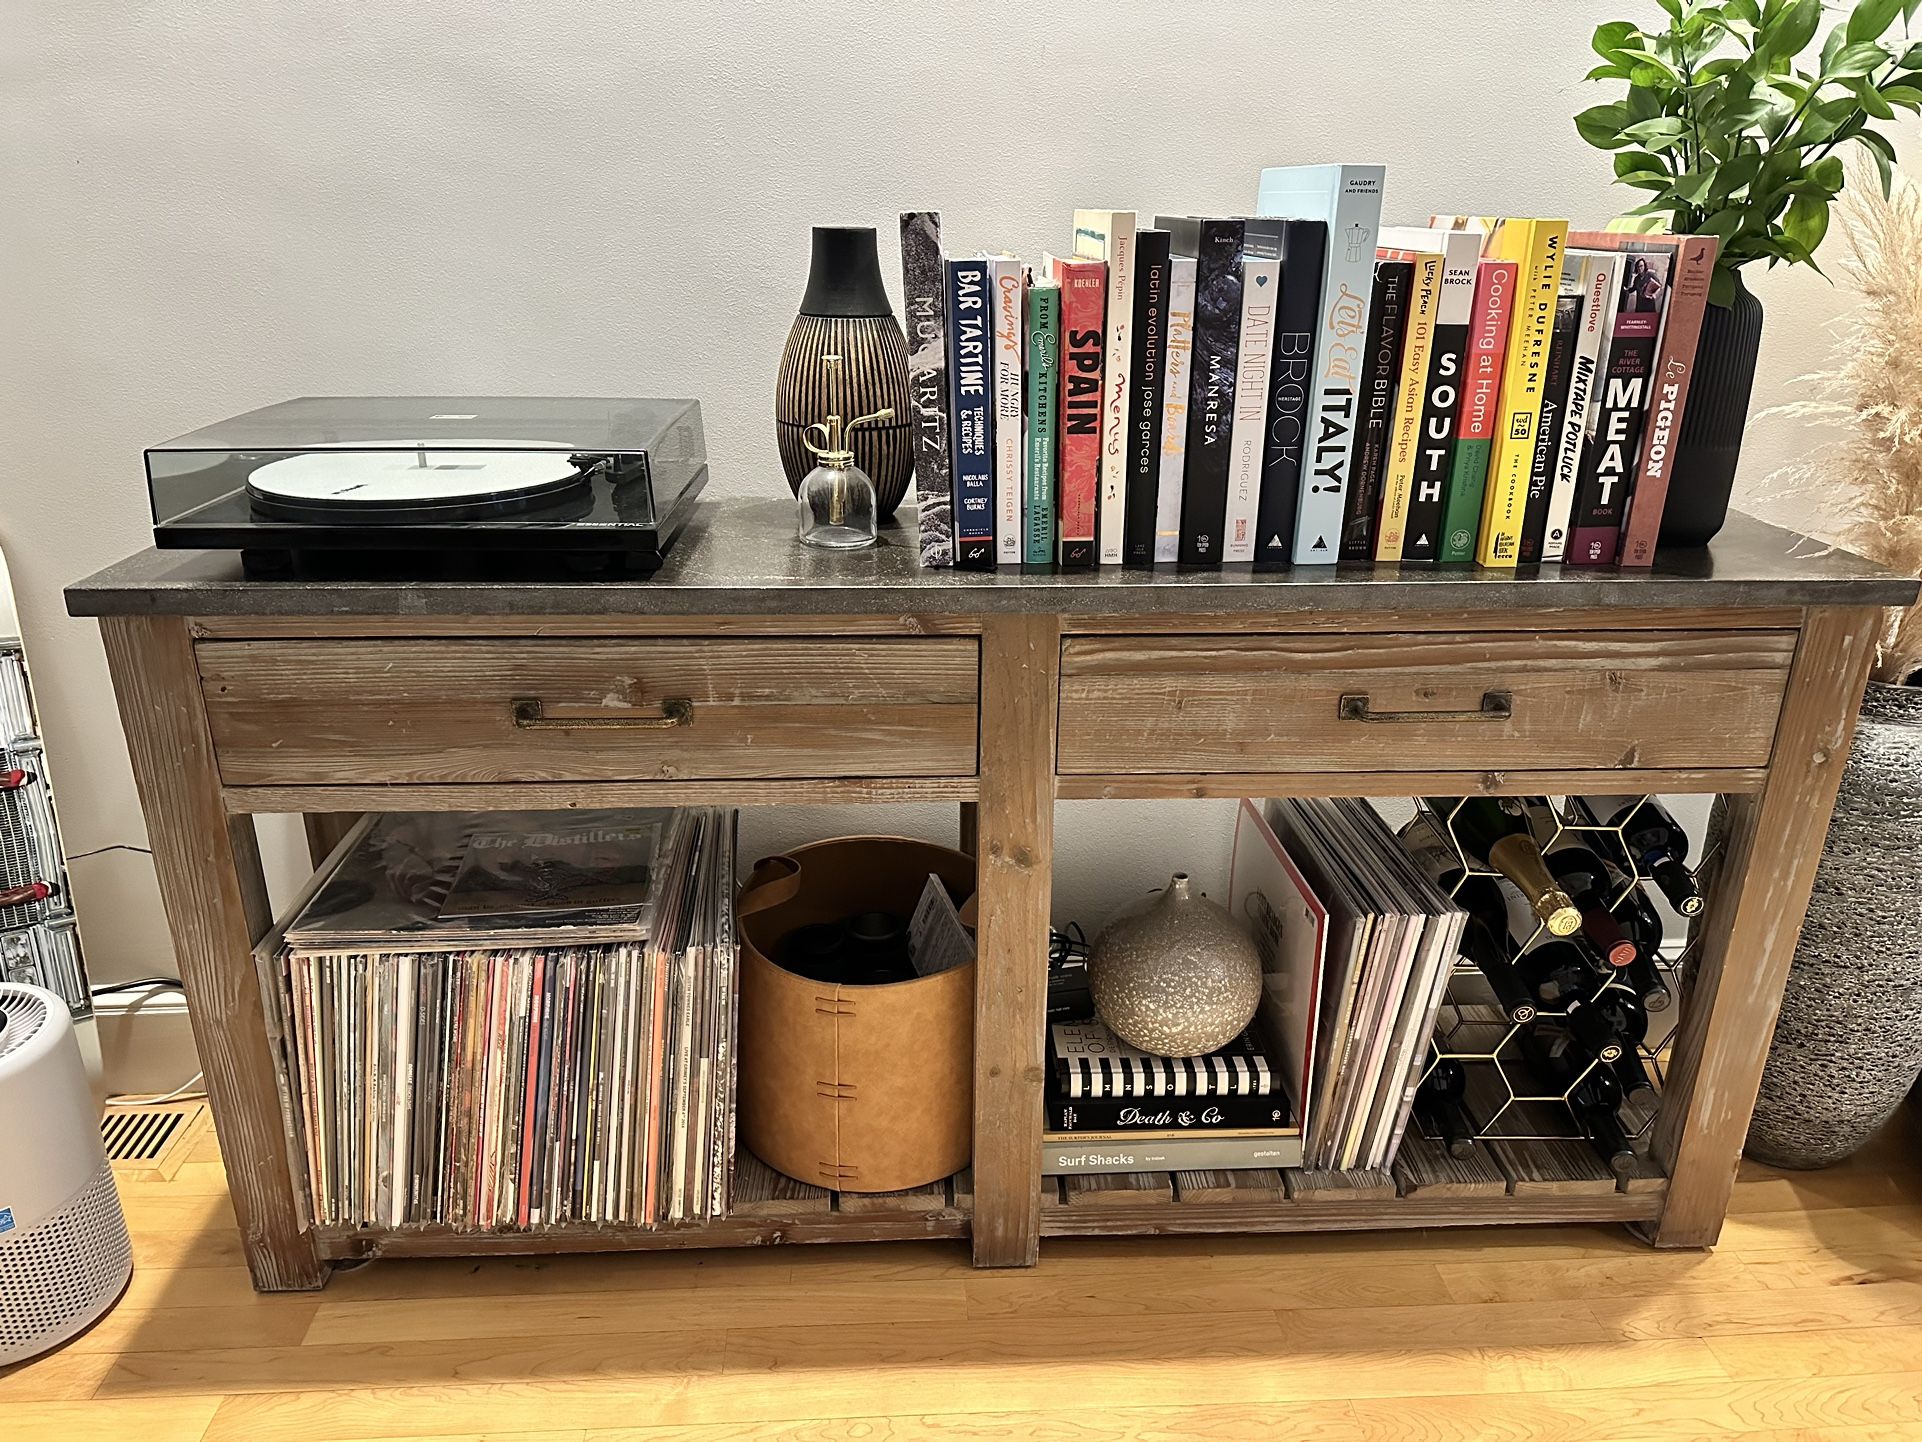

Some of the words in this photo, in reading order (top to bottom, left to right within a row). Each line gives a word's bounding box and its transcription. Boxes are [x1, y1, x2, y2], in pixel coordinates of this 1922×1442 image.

[1116, 236, 1128, 272] Jacques
[1541, 236, 1558, 290] WYLIE
[958, 270, 982, 310] BAR
[1074, 278, 1100, 288] KOEHLER
[1116, 274, 1126, 301] Pépin
[1150, 265, 1162, 303] latin
[1385, 276, 1398, 300] THE
[1528, 289, 1537, 318] PETER
[1587, 273, 1606, 332] Questlove
[994, 275, 1020, 366] Cravings
[1040, 297, 1048, 330] FROM
[1245, 306, 1270, 348] DATE
[1417, 322, 1427, 340] 101
[1479, 269, 1508, 349] Cooking
[958, 316, 984, 396] TARTINE
[1144, 308, 1160, 381] evolution
[1376, 304, 1398, 376] FLAVOR
[1409, 342, 1424, 374] Easy
[1520, 326, 1531, 366] MEEHAN
[1526, 303, 1548, 392] DUFRESNE
[1000, 361, 1010, 386] FOR
[1066, 330, 1100, 435] SPAIN
[1241, 354, 1266, 401] NIGHT
[1324, 342, 1359, 394] Eat
[1478, 355, 1492, 374] at
[1666, 355, 1686, 379] Le
[1000, 388, 1009, 420] MORE
[1010, 372, 1020, 418] HUNGRY
[1038, 372, 1048, 434] KITCHENS
[1142, 386, 1155, 417] jose
[1204, 355, 1222, 445] MANRESA
[1268, 333, 1310, 467] BROCK
[1369, 380, 1388, 429] BIBLE
[1405, 376, 1420, 413] Asian
[1470, 380, 1492, 433] Home
[1571, 355, 1595, 419] MIXTAPE
[960, 410, 970, 420] &
[973, 406, 984, 456] TECHNIQUES
[1108, 373, 1126, 456] menus
[1239, 406, 1262, 421] IN
[1418, 353, 1457, 502] SOUTH
[1516, 416, 1528, 424] wd
[1646, 383, 1679, 478] PIGEON
[962, 421, 973, 454] RECIPES
[1140, 421, 1151, 474] garces
[1311, 388, 1353, 494] ITALY!
[1362, 442, 1370, 470] ANDREW
[1398, 417, 1414, 463] Recipes
[1534, 400, 1558, 472] American
[1560, 421, 1582, 484] POTLUCK
[1596, 378, 1643, 505] MEAT
[1005, 438, 1014, 481] CHRISSY
[1238, 440, 1252, 502] RODRIGUEZ
[1005, 486, 1014, 522] TEIGEN
[1505, 474, 1516, 519] COOKBOOK
[1530, 475, 1546, 499] Pie
[472, 836, 518, 850] The
[1085, 1033, 1106, 1053] OF
[1117, 1107, 1173, 1125] Death
[1178, 1111, 1196, 1126] &
[1202, 1107, 1225, 1124] Co
[1059, 1155, 1086, 1166] Surf
[1089, 1154, 1134, 1165] Shacks
